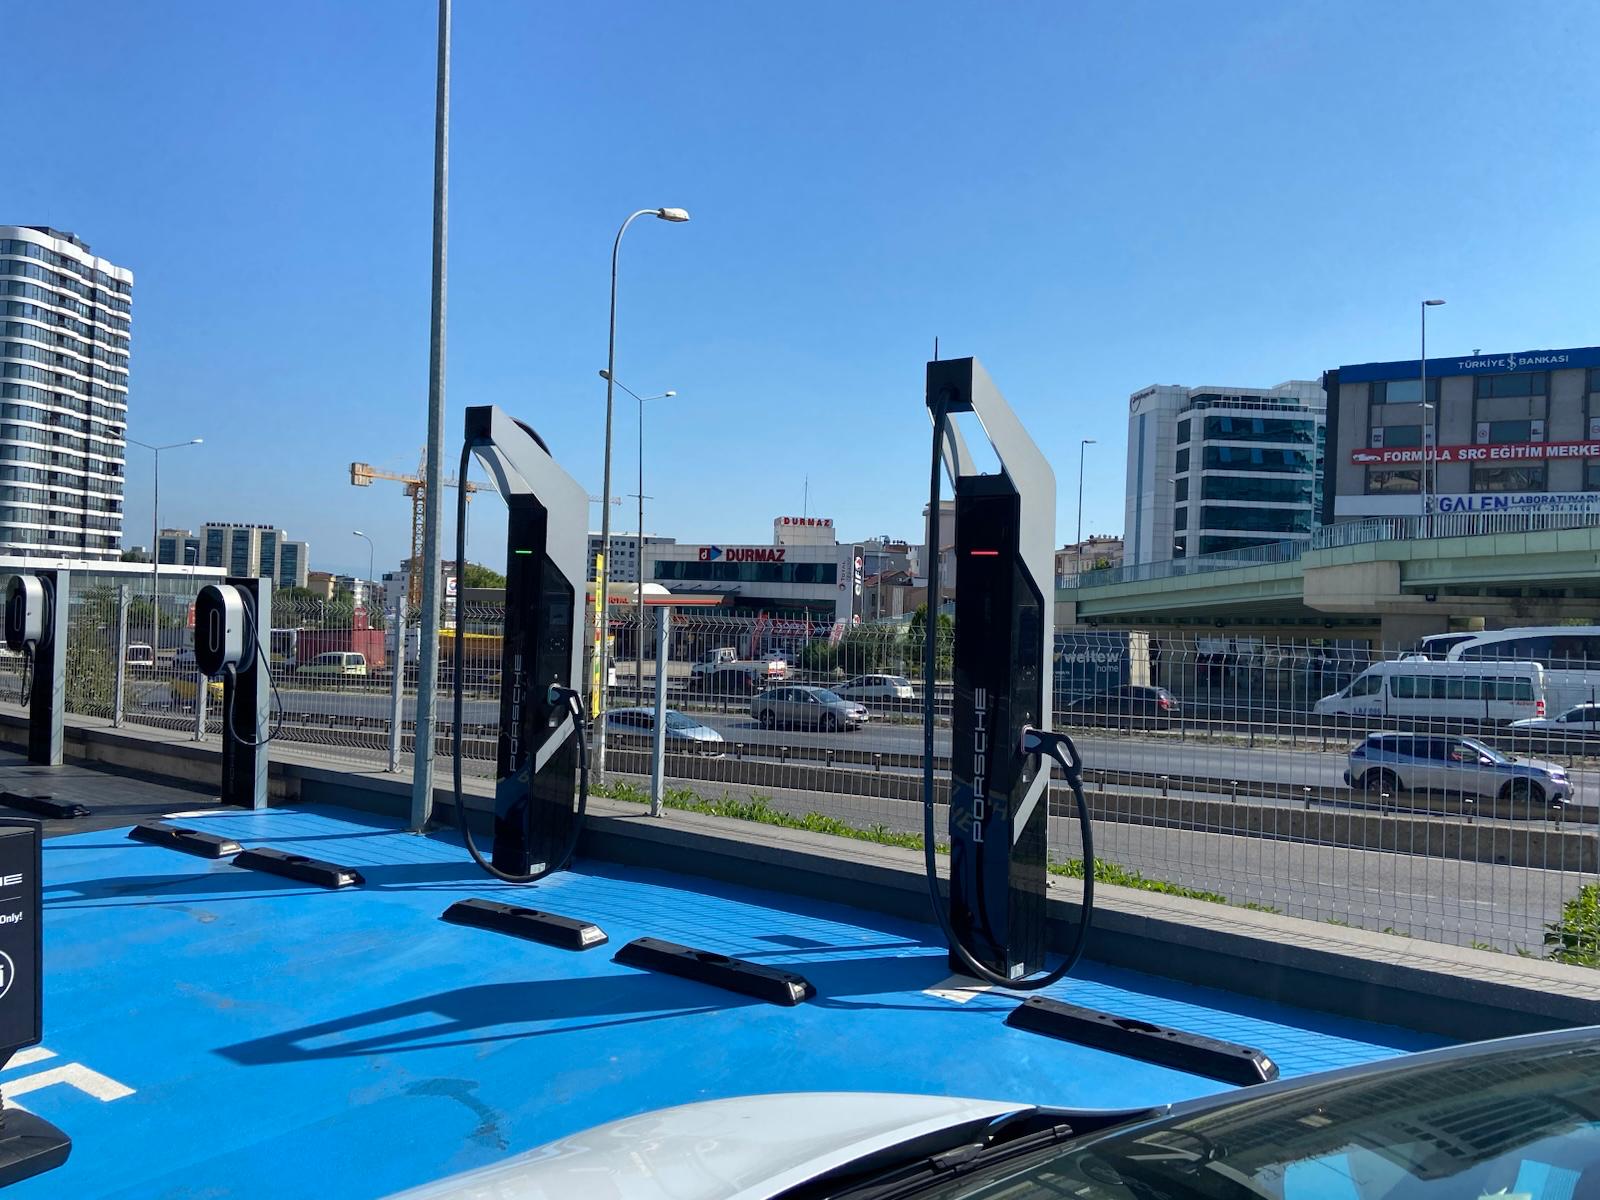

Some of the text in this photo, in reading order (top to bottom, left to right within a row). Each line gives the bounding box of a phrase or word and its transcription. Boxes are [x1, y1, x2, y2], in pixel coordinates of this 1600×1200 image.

[1458, 355, 1569, 369] TÜRKİYE BANKASI
[1383, 444, 1600, 462] FORMULA SRC EĞİTİM MERKE
[1439, 496, 1509, 512] GALEN
[783, 517, 830, 527] DURMAZ
[726, 548, 786, 562] DURMAZ
[509, 654, 522, 772] PORSCHE
[973, 687, 987, 843] PORSCHE
